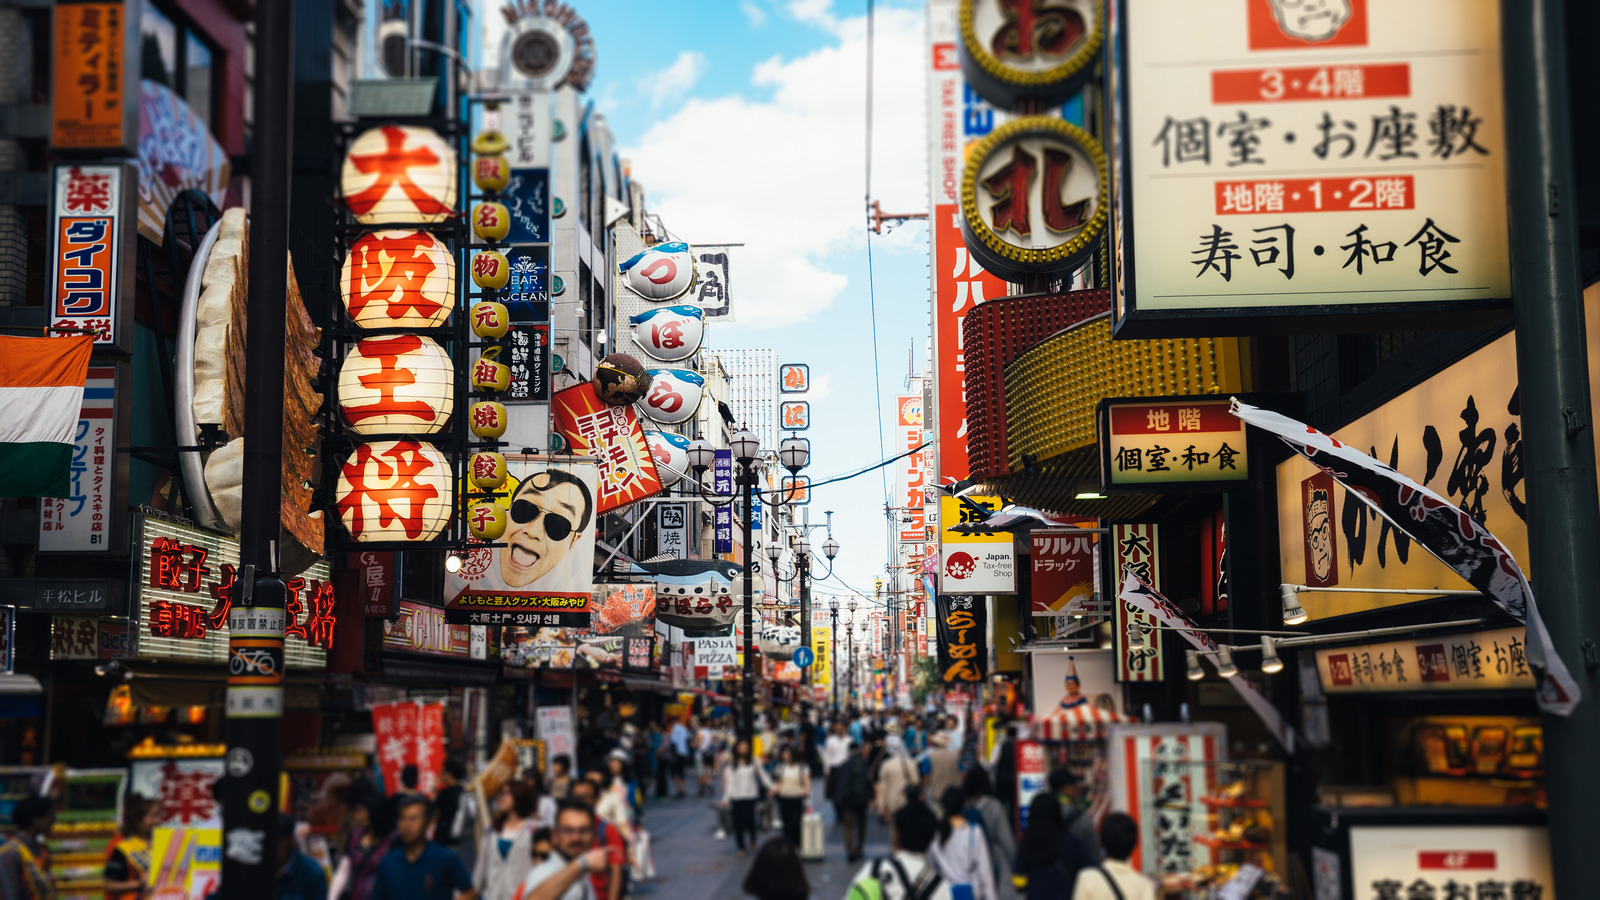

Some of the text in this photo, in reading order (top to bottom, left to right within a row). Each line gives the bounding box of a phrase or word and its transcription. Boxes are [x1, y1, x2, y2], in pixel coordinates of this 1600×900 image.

[1260, 68, 1364, 99] 3・4階
[1152, 105, 1491, 168] 個室・お座敷
[65, 167, 111, 212] 薬
[942, 156, 957, 199] SHOP
[1222, 178, 1406, 212] 地階・1・2階
[1191, 218, 1461, 282] 寿司・和食
[63, 219, 108, 315] ダイコク
[511, 275, 538, 285] BAR
[554, 280, 561, 289] 3
[335, 126, 457, 540] 大阪王将
[511, 330, 529, 398] 海鮮物語
[554, 359, 561, 368] 2
[784, 367, 806, 500] かに楽
[1147, 408, 1201, 431] 地階
[1114, 442, 1240, 472] 個室・和食
[91, 427, 105, 531] タイ料理とタイスキの店
[907, 429, 924, 530] ジャンカラ
[985, 553, 1012, 562] Japan.
[1033, 537, 1091, 555] ツルハ
[153, 537, 210, 592] 餃子
[982, 562, 1012, 570] Tax-free
[993, 570, 1012, 578] Shop
[1034, 559, 1081, 572] ドラッグ
[41, 589, 102, 603] 平松ビル
[458, 596, 586, 607] よしもと芸人グッズ・大阪みやげ
[657, 595, 733, 615] づぼらや
[543, 614, 560, 625] 선물
[698, 640, 733, 648] PASTA
[699, 653, 733, 664] PIZZA
[943, 610, 982, 682] らーめん
[160, 761, 218, 826] 薬
